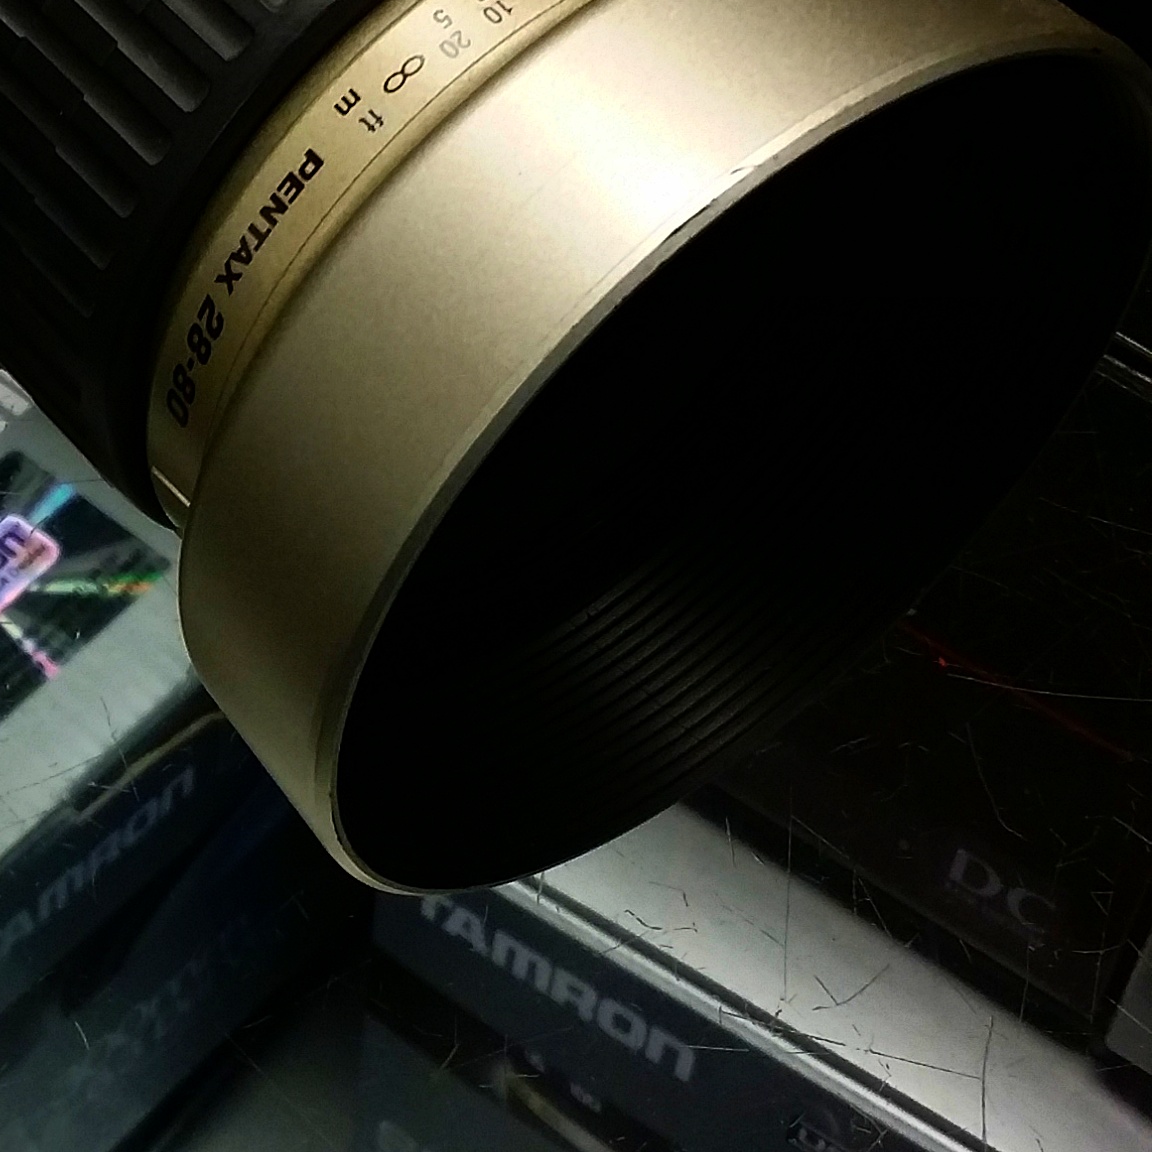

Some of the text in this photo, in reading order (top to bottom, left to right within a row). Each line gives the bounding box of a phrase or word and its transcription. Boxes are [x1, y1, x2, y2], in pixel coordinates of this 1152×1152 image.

[332, 88, 362, 118] m
[432, 9, 454, 30] 5
[358, 107, 385, 134] ft
[438, 29, 472, 60] 20
[165, 147, 325, 429] PENTAX 28-80
[944, 846, 1058, 935] DC
[420, 893, 698, 1084] TAMRON
